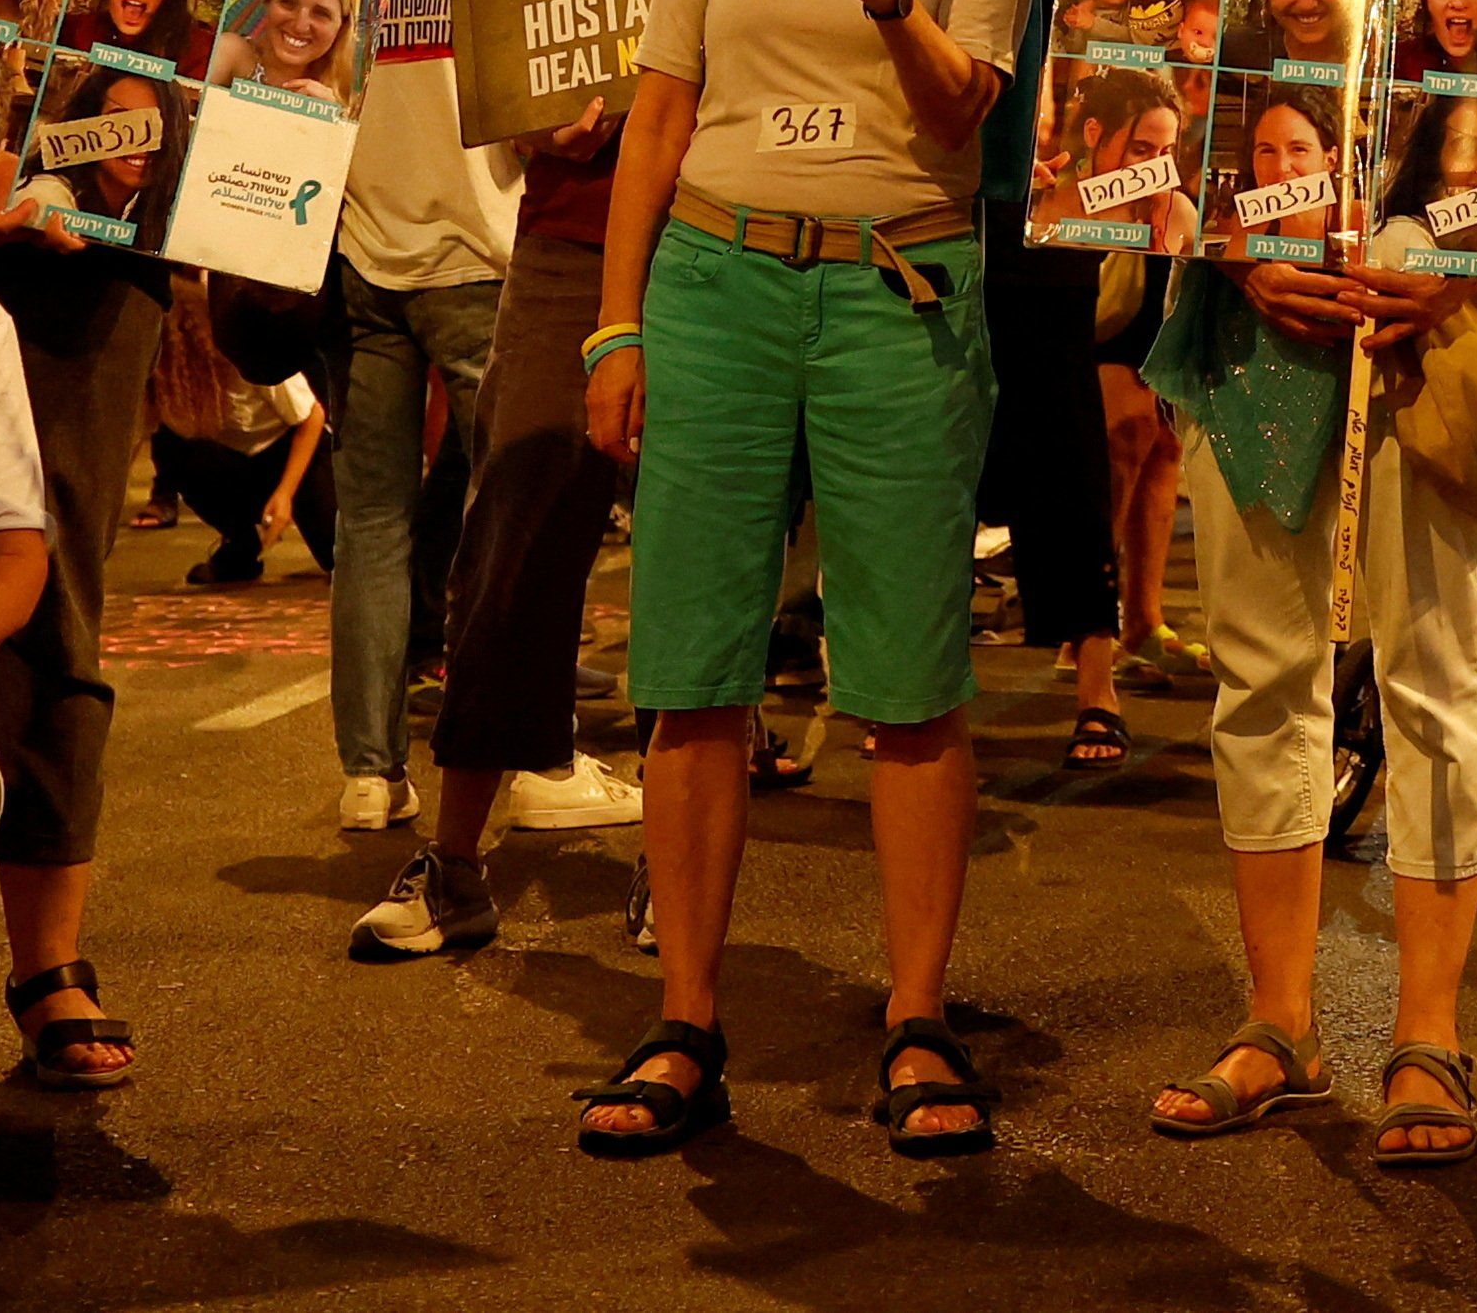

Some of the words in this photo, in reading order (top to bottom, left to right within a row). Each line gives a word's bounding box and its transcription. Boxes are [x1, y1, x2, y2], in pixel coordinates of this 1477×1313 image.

[96, 47, 122, 61] יהוד
[1092, 48, 1127, 61] ביבס
[1131, 51, 1163, 64] שירי
[128, 54, 162, 73] ארבל
[529, 48, 612, 98] DEAL
[1282, 64, 1304, 78] גונן
[1310, 67, 1338, 80] רומי
[1426, 76, 1456, 91] יהוד
[772, 109, 845, 146] 367
[262, 171, 291, 184] נשים
[250, 181, 289, 197] עושות
[1083, 162, 1170, 210] נרצחה!
[255, 196, 285, 210] שלום
[1239, 181, 1326, 224] נרצחה!
[108, 222, 131, 239] עדן
[1111, 229, 1143, 243] ענבר
[1255, 242, 1276, 255] גת
[1281, 243, 1317, 258] כרמל
